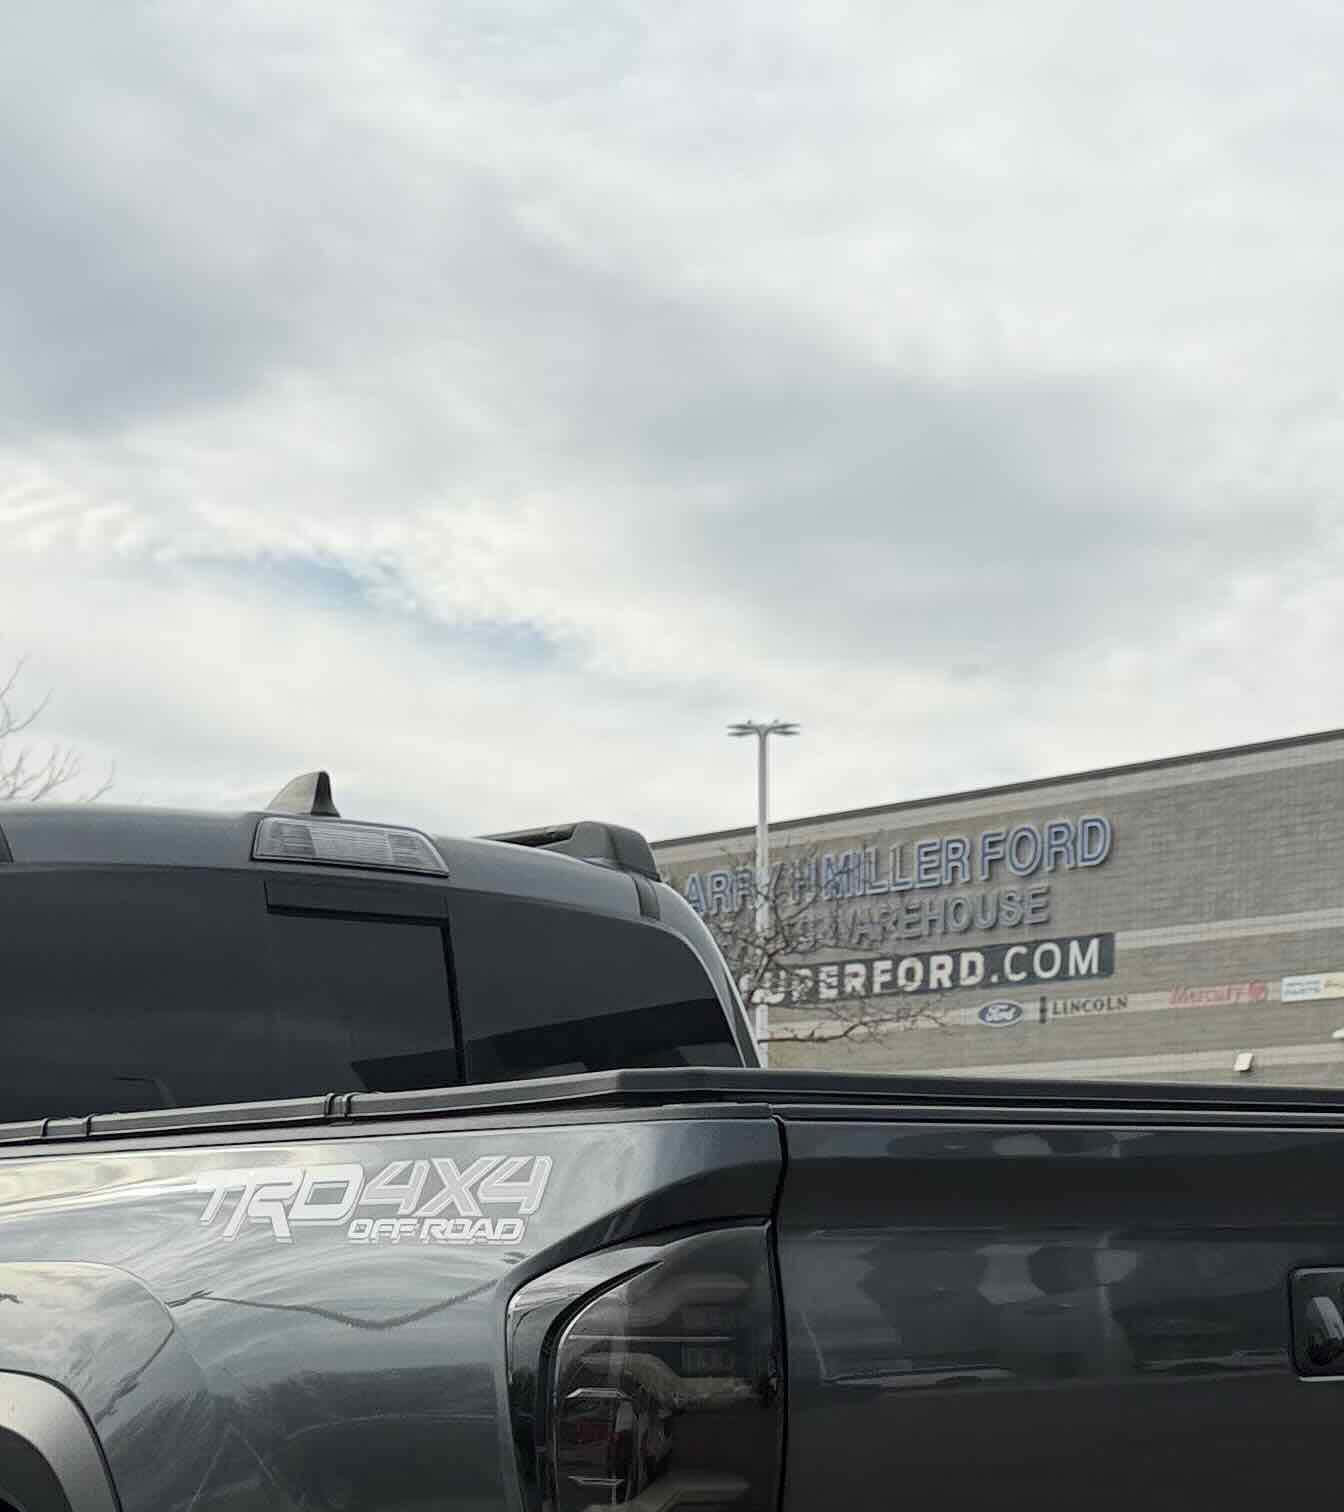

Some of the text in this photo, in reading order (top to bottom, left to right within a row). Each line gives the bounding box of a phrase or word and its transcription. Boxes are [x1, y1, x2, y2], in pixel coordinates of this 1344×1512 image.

[821, 838, 972, 900] MILLER
[978, 814, 1114, 883] FORD
[1052, 994, 1129, 1016] LINCOLN
